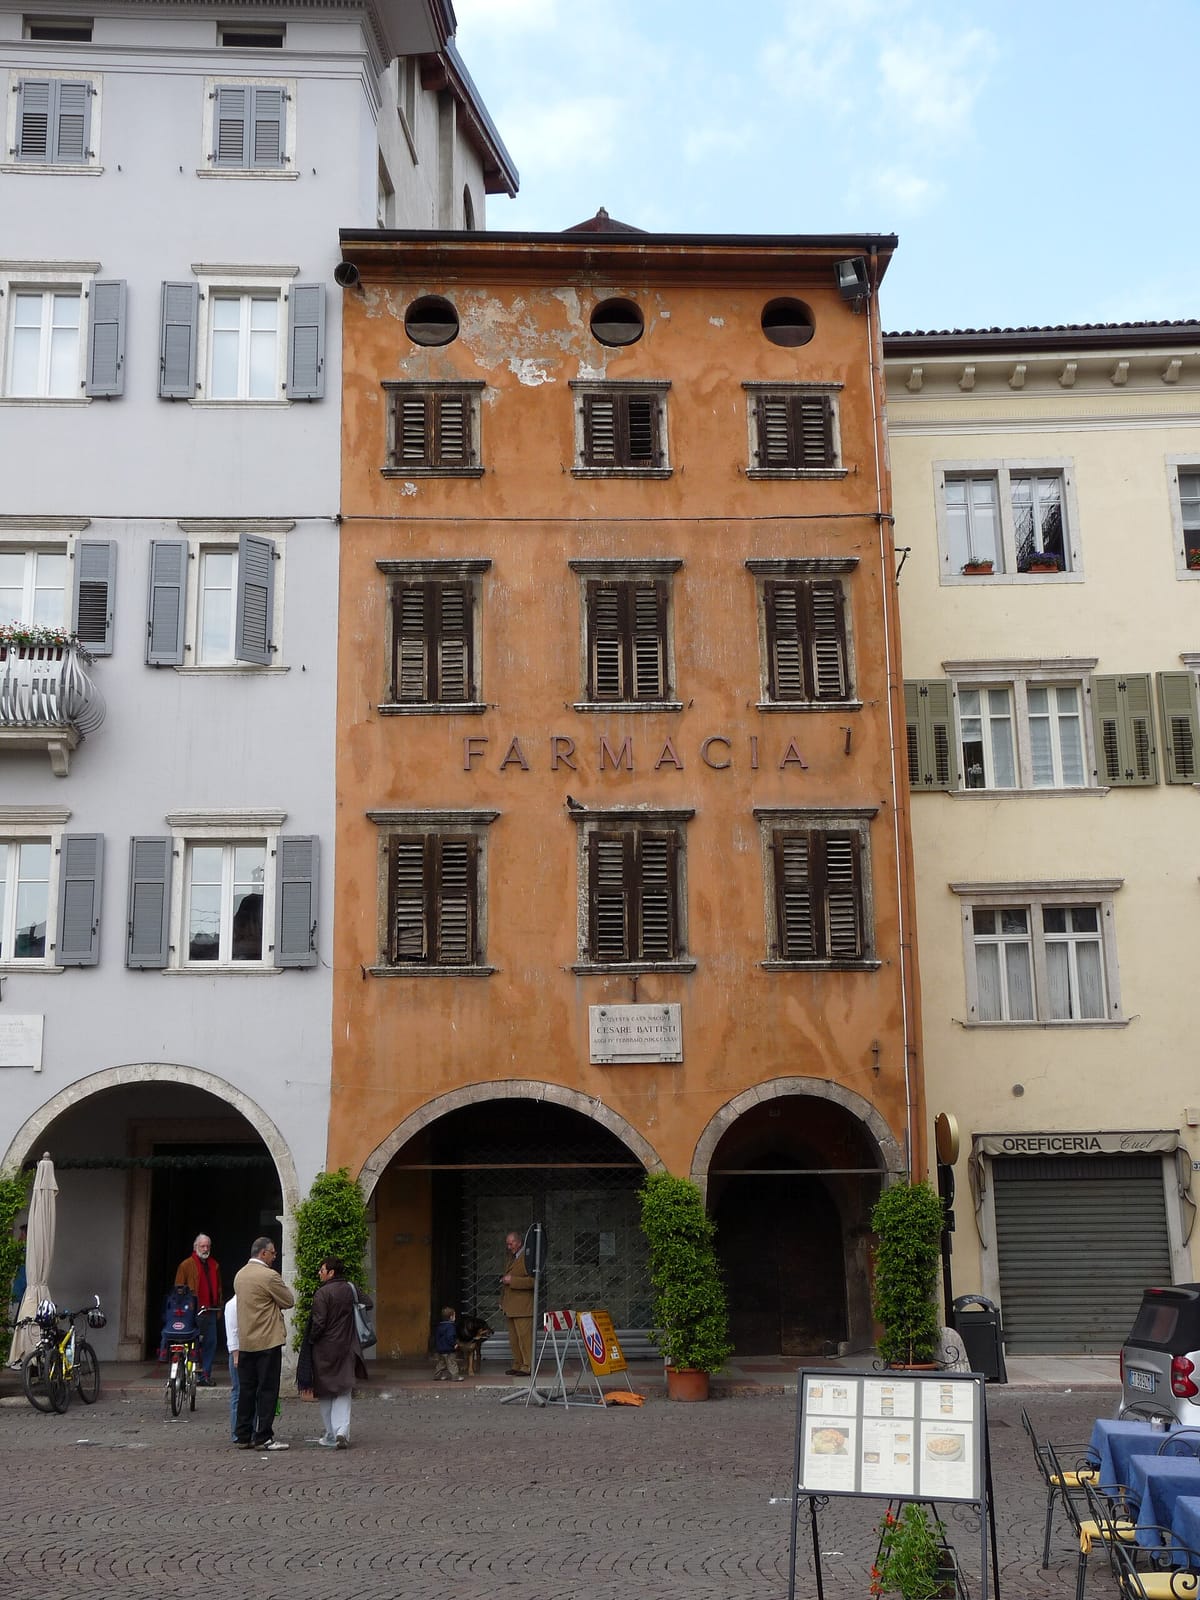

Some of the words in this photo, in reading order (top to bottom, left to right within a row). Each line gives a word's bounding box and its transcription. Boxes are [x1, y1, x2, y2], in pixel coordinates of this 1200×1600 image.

[463, 735, 809, 771] FARMACIA
[596, 1025, 632, 1034] CESARE
[637, 1025, 676, 1034] BATTISTI
[1002, 1137, 1101, 1151] OREFICERIA
